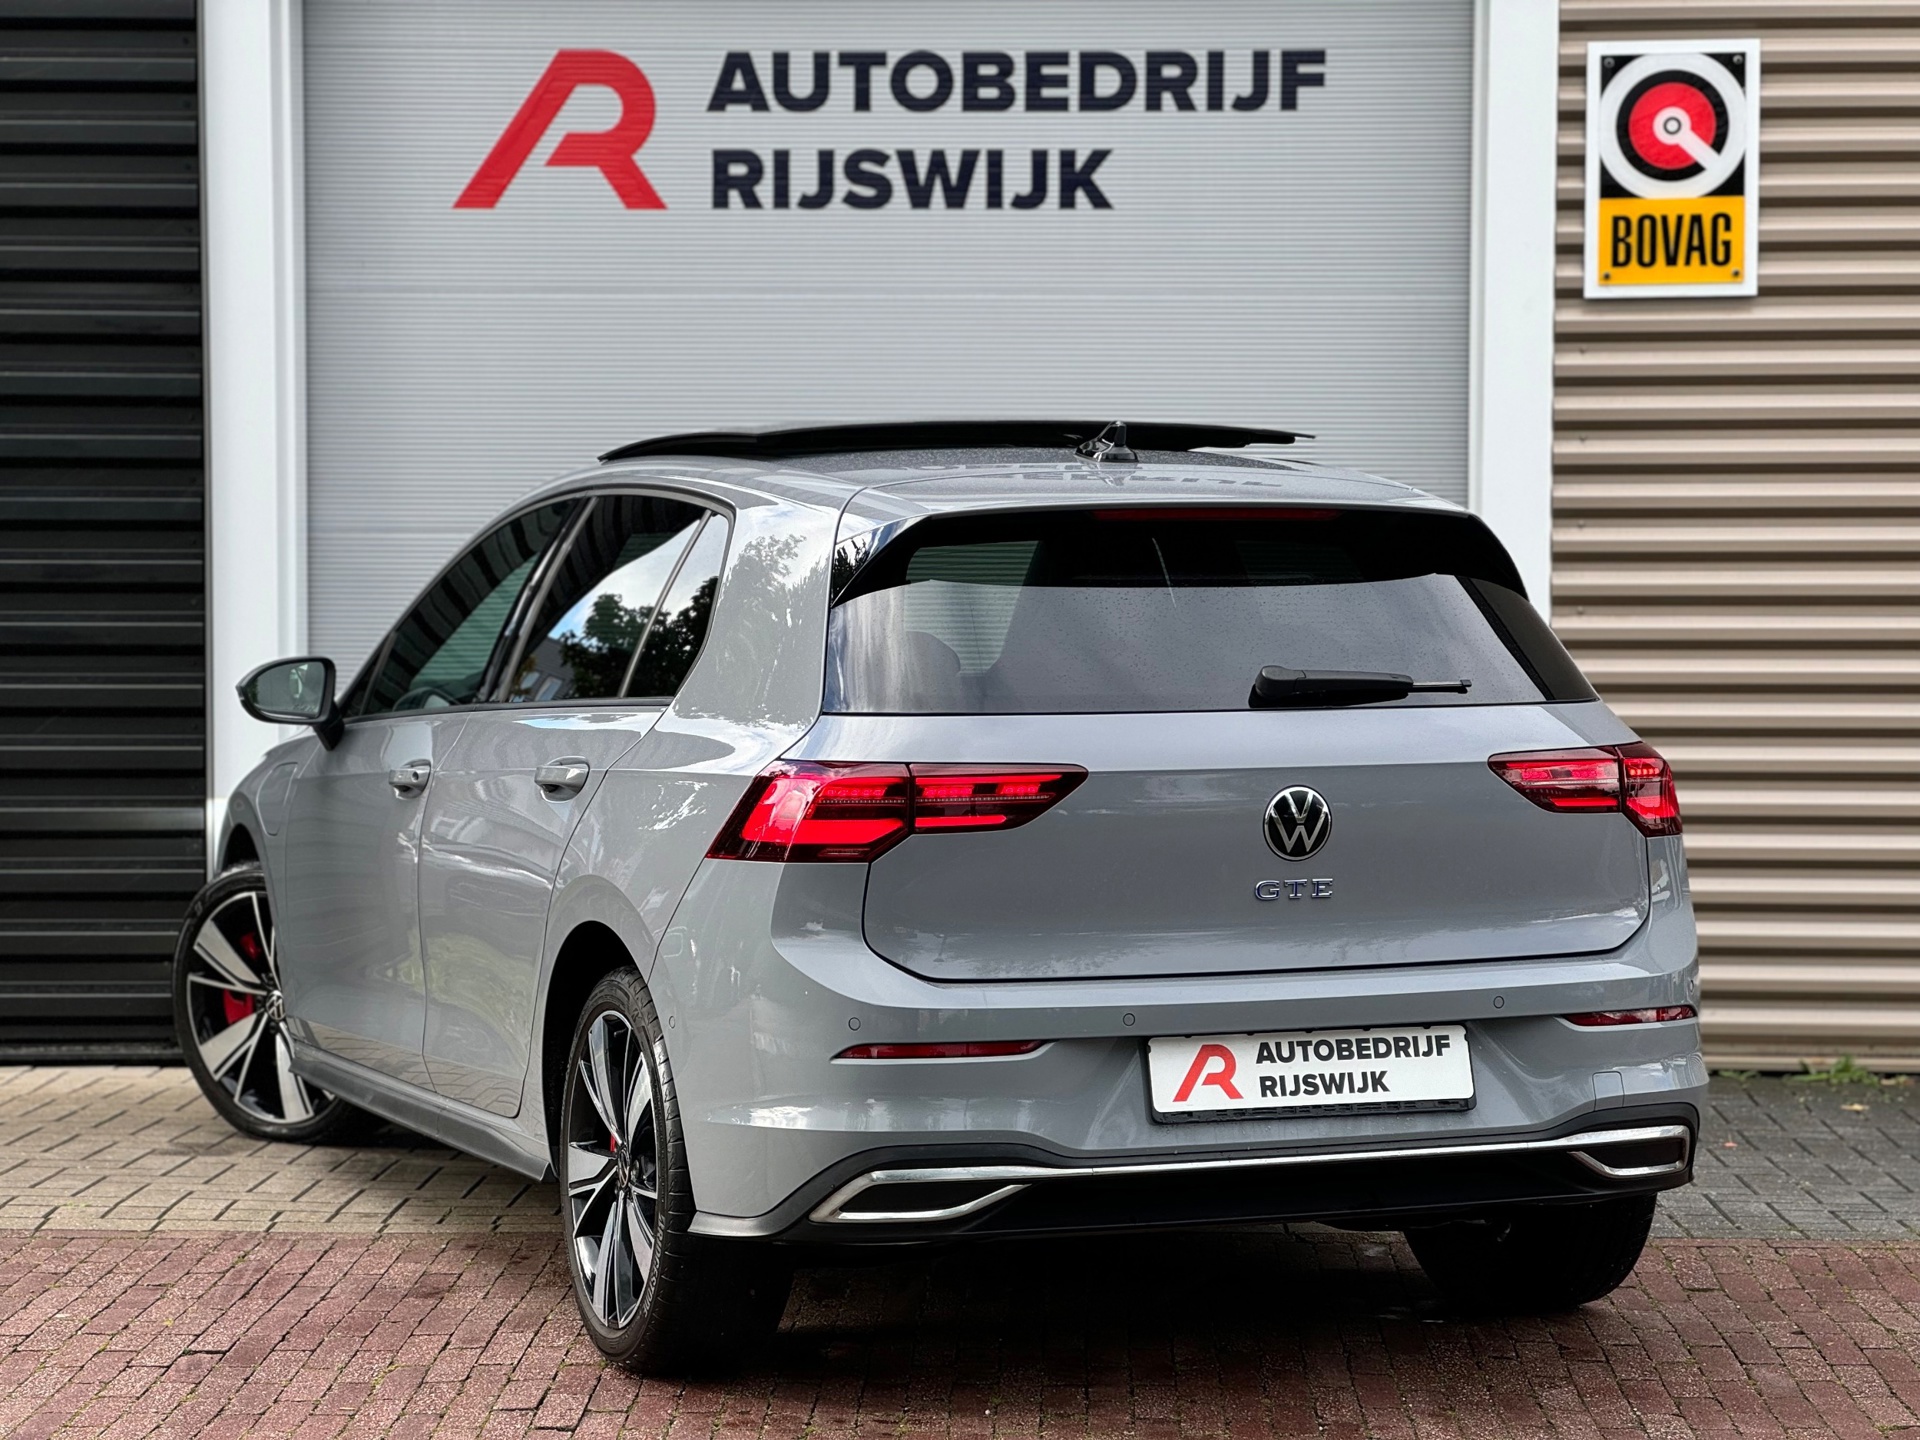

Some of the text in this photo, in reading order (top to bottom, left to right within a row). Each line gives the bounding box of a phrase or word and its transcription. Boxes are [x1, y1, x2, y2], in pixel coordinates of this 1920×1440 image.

[706, 48, 1327, 113] AUTOBEDRIJF
[711, 148, 1114, 210] RIJSWIJK
[1611, 212, 1732, 268] BOVAG
[1255, 878, 1334, 901] GTE
[1255, 1034, 1451, 1065] AUTOBEDRIJF
[1258, 1070, 1391, 1098] RIJSWIJK
